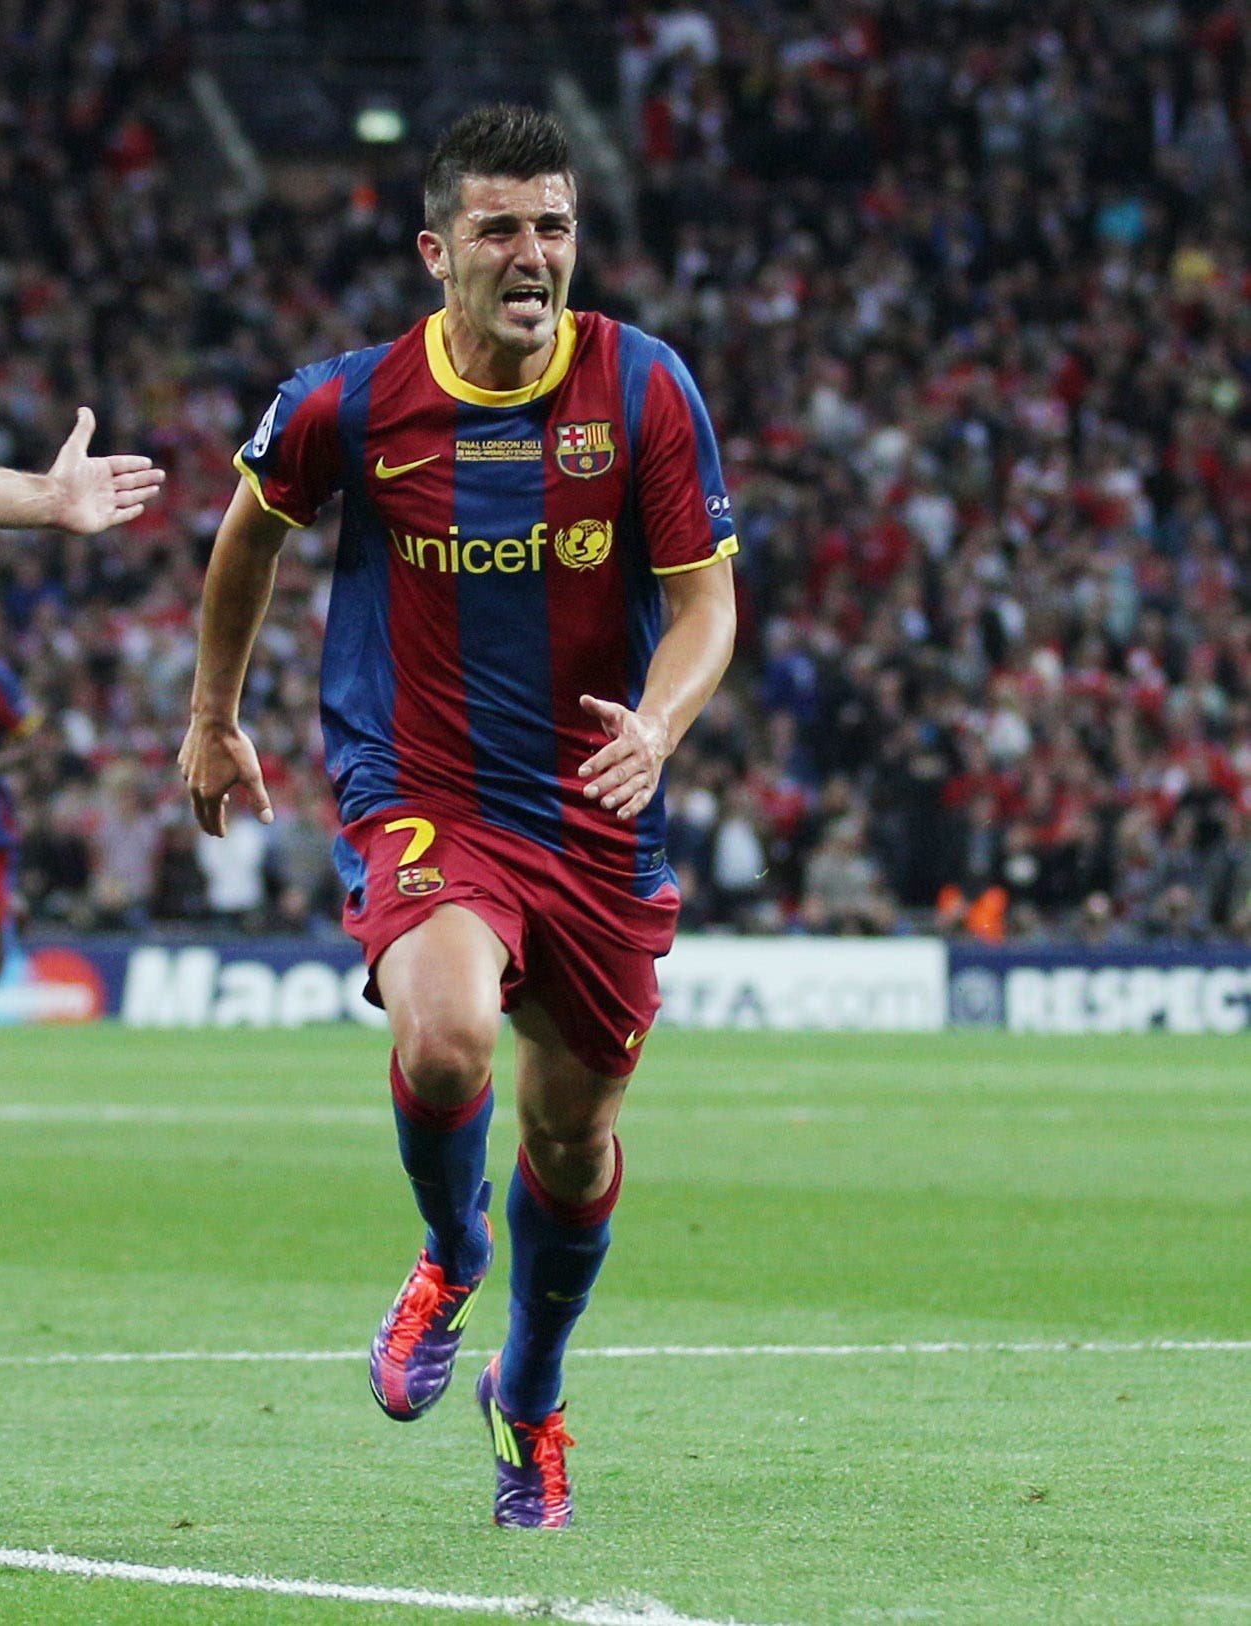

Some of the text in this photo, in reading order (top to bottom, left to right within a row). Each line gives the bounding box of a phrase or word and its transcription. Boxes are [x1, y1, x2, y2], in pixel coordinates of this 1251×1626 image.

[455, 440, 541, 449] FINAL LONDON 2011
[390, 522, 548, 575] unicef
[384, 817, 436, 867] 7
[1006, 965, 1251, 1033] RESPEC
